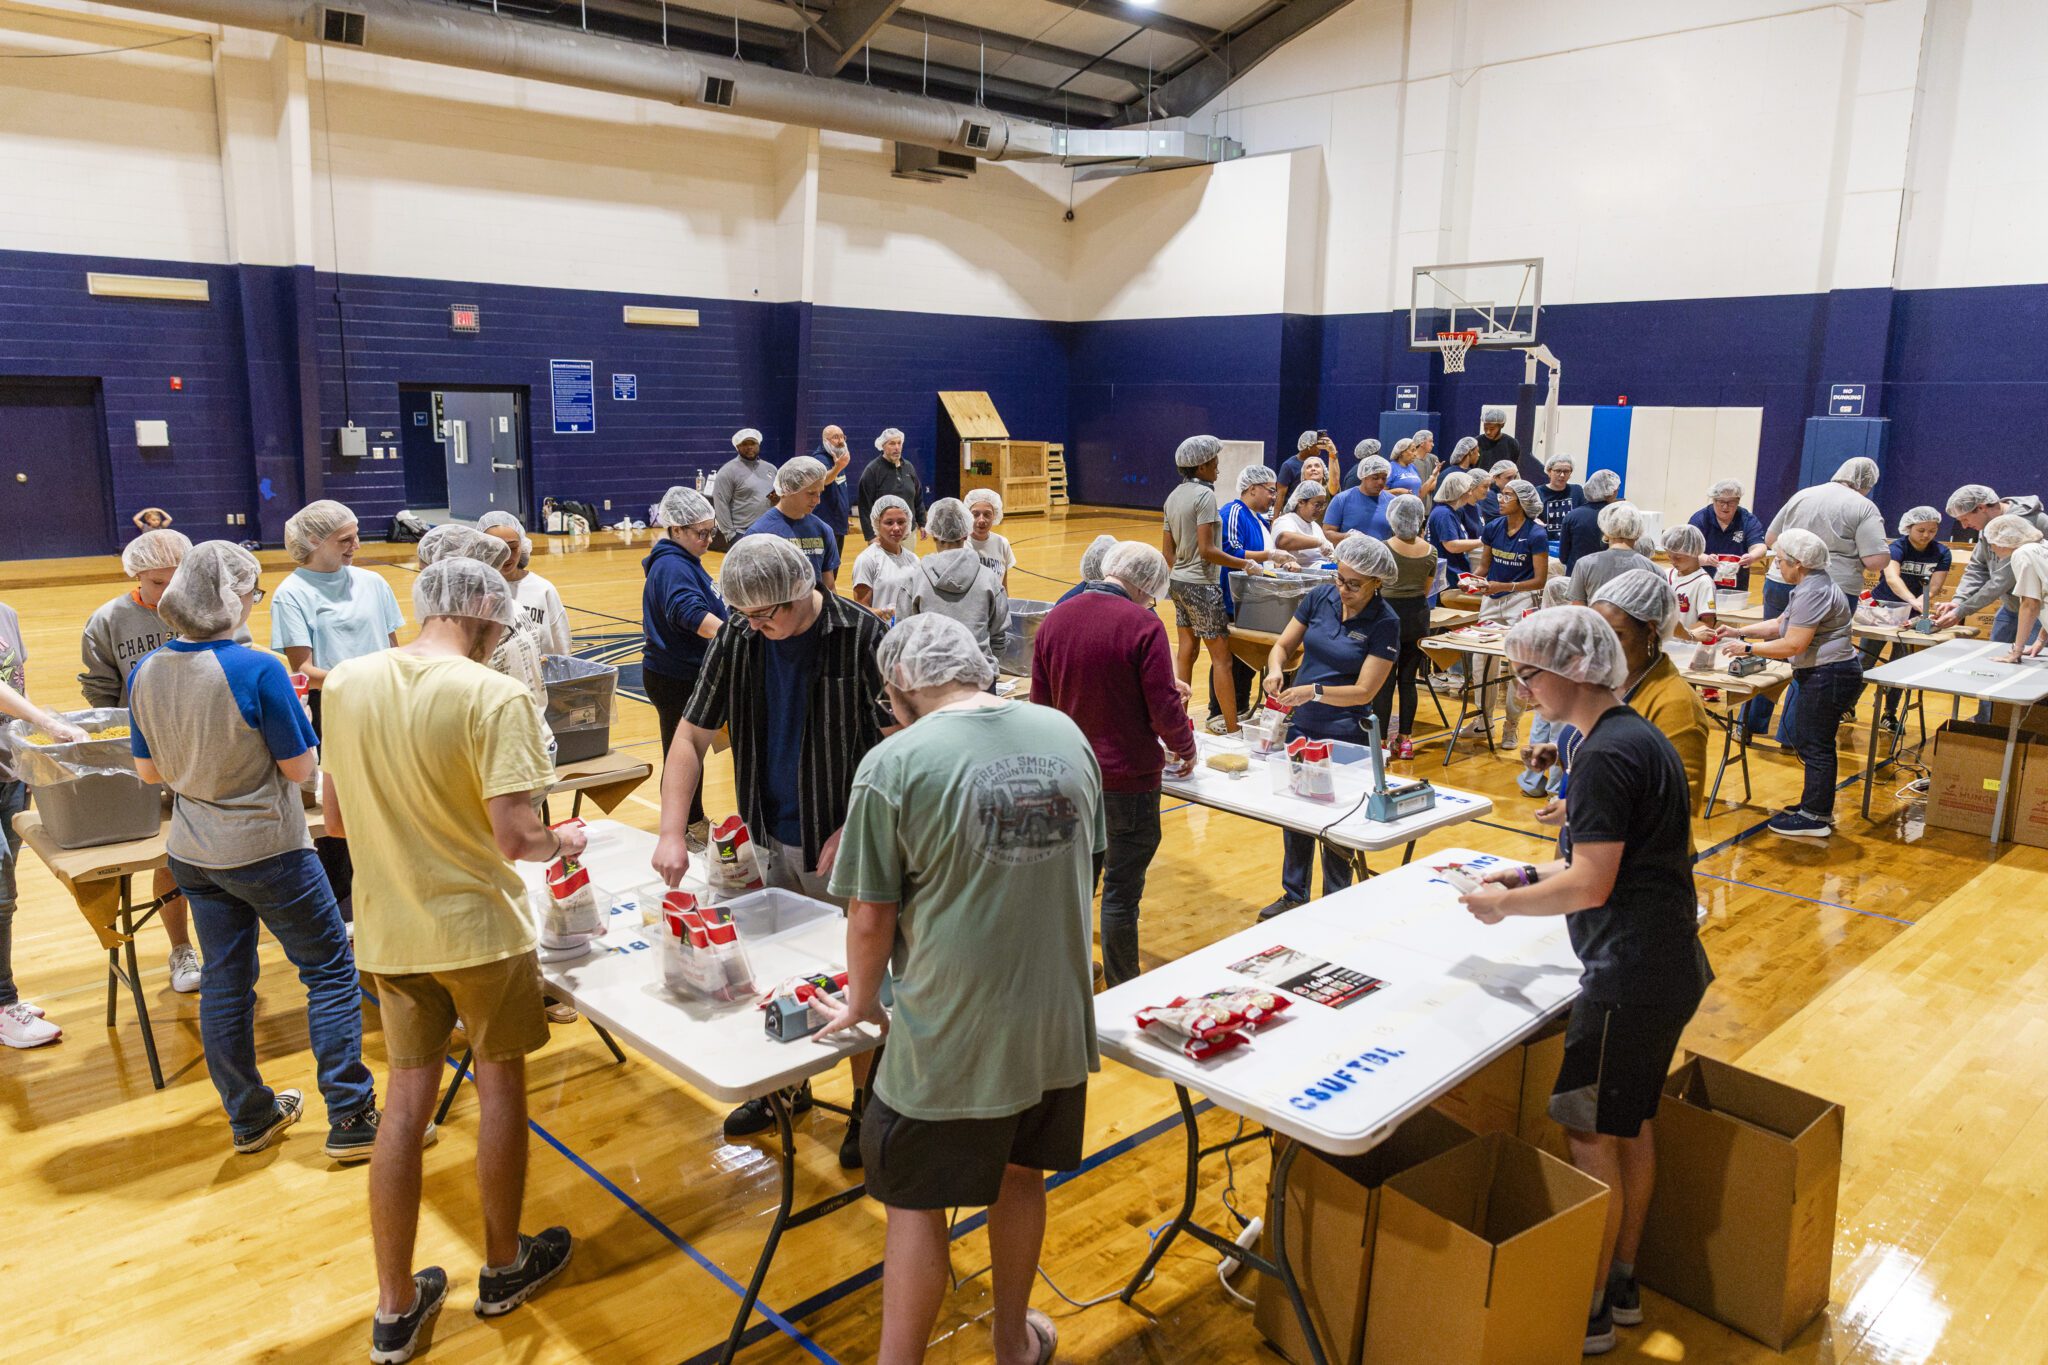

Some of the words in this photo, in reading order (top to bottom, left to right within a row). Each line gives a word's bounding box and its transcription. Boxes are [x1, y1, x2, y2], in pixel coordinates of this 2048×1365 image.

[974, 759, 1011, 788] GREAT
[1017, 756, 1067, 775] SMOKY
[990, 766, 1054, 784] MOUNTAINS
